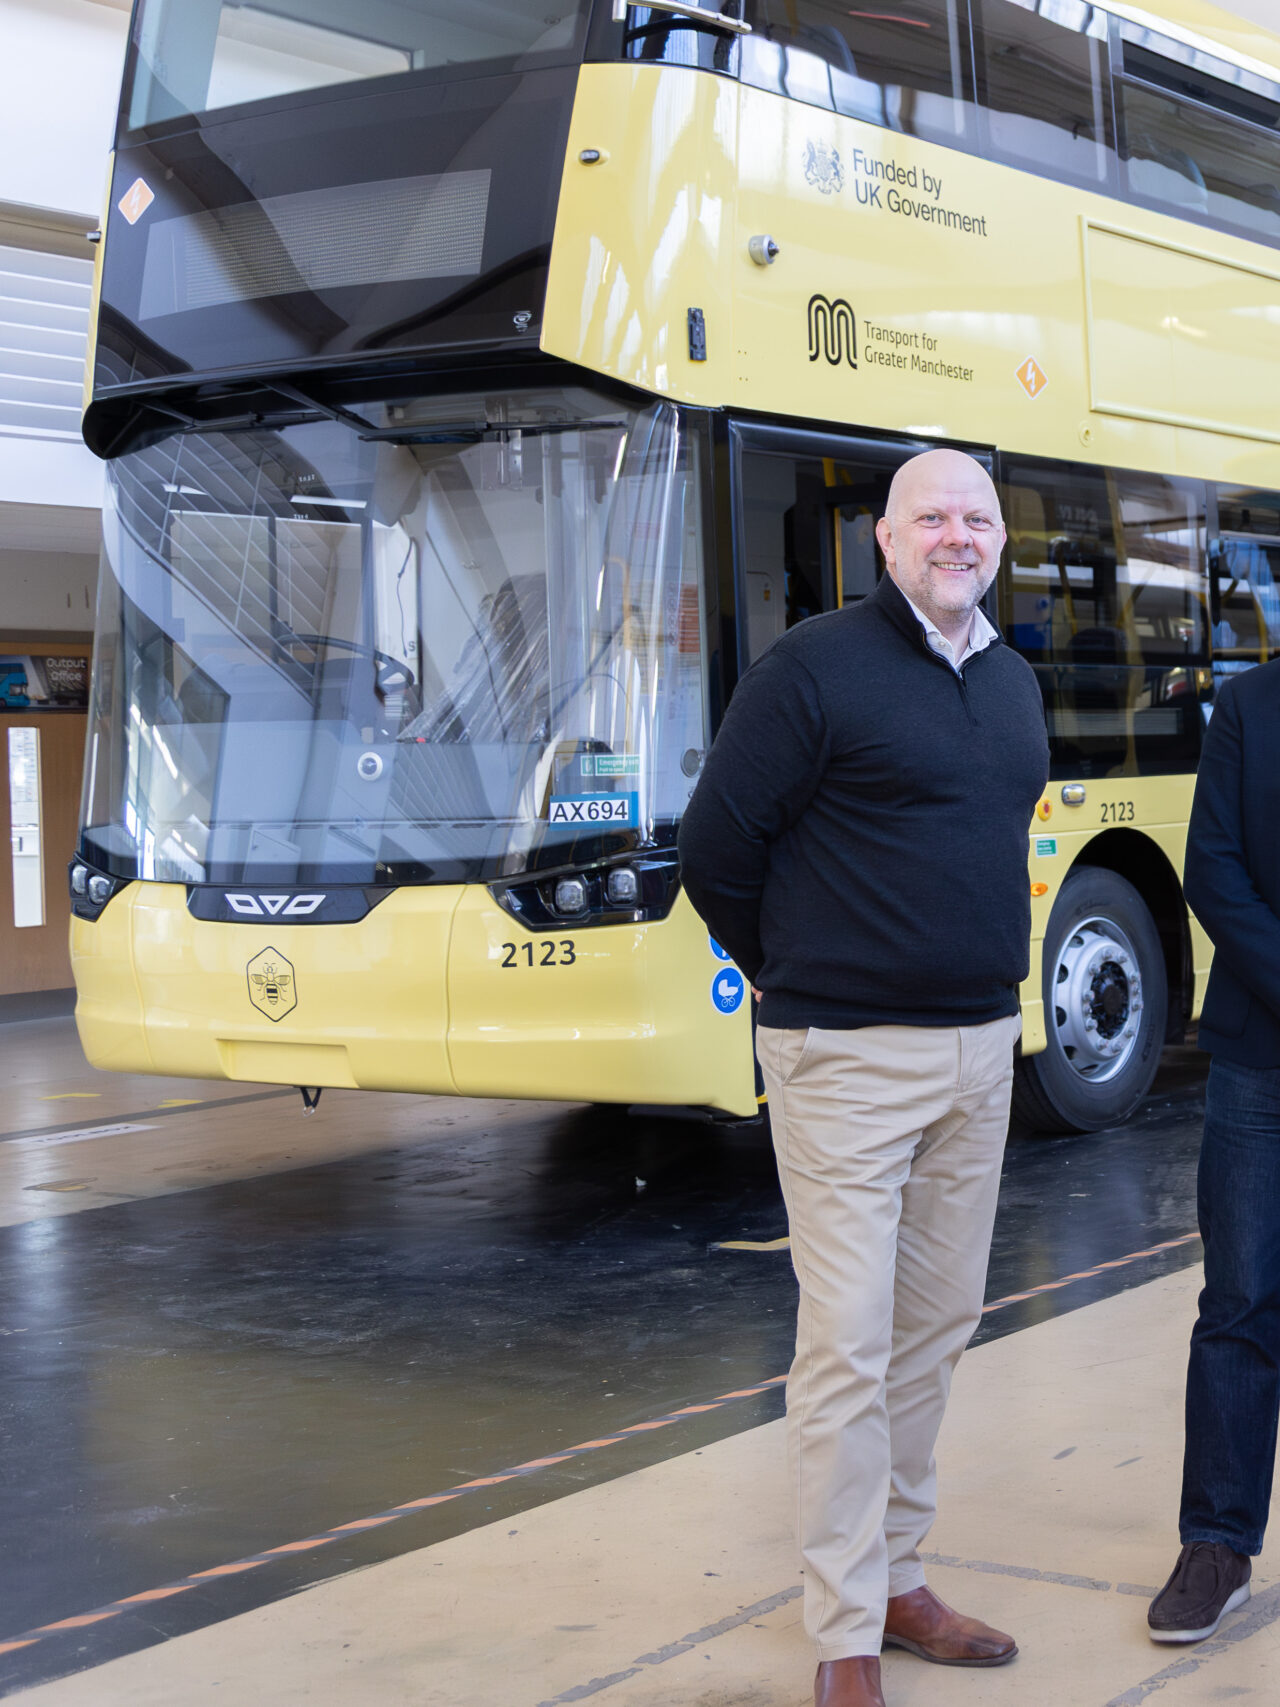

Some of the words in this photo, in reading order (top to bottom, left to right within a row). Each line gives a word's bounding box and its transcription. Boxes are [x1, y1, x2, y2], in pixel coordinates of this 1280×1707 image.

[852, 148, 917, 188] Funded
[922, 168, 942, 200] by
[855, 179, 883, 209] UK
[887, 188, 988, 237] Government
[864, 320, 919, 349] Transport
[922, 333, 938, 352] for
[864, 345, 907, 369] Greater
[911, 354, 974, 382] Manchester
[46, 658, 86, 669] Output
[50, 671, 82, 680] Office
[552, 801, 628, 822] AX694
[1100, 801, 1135, 823] 2123
[501, 940, 577, 968] 2123
